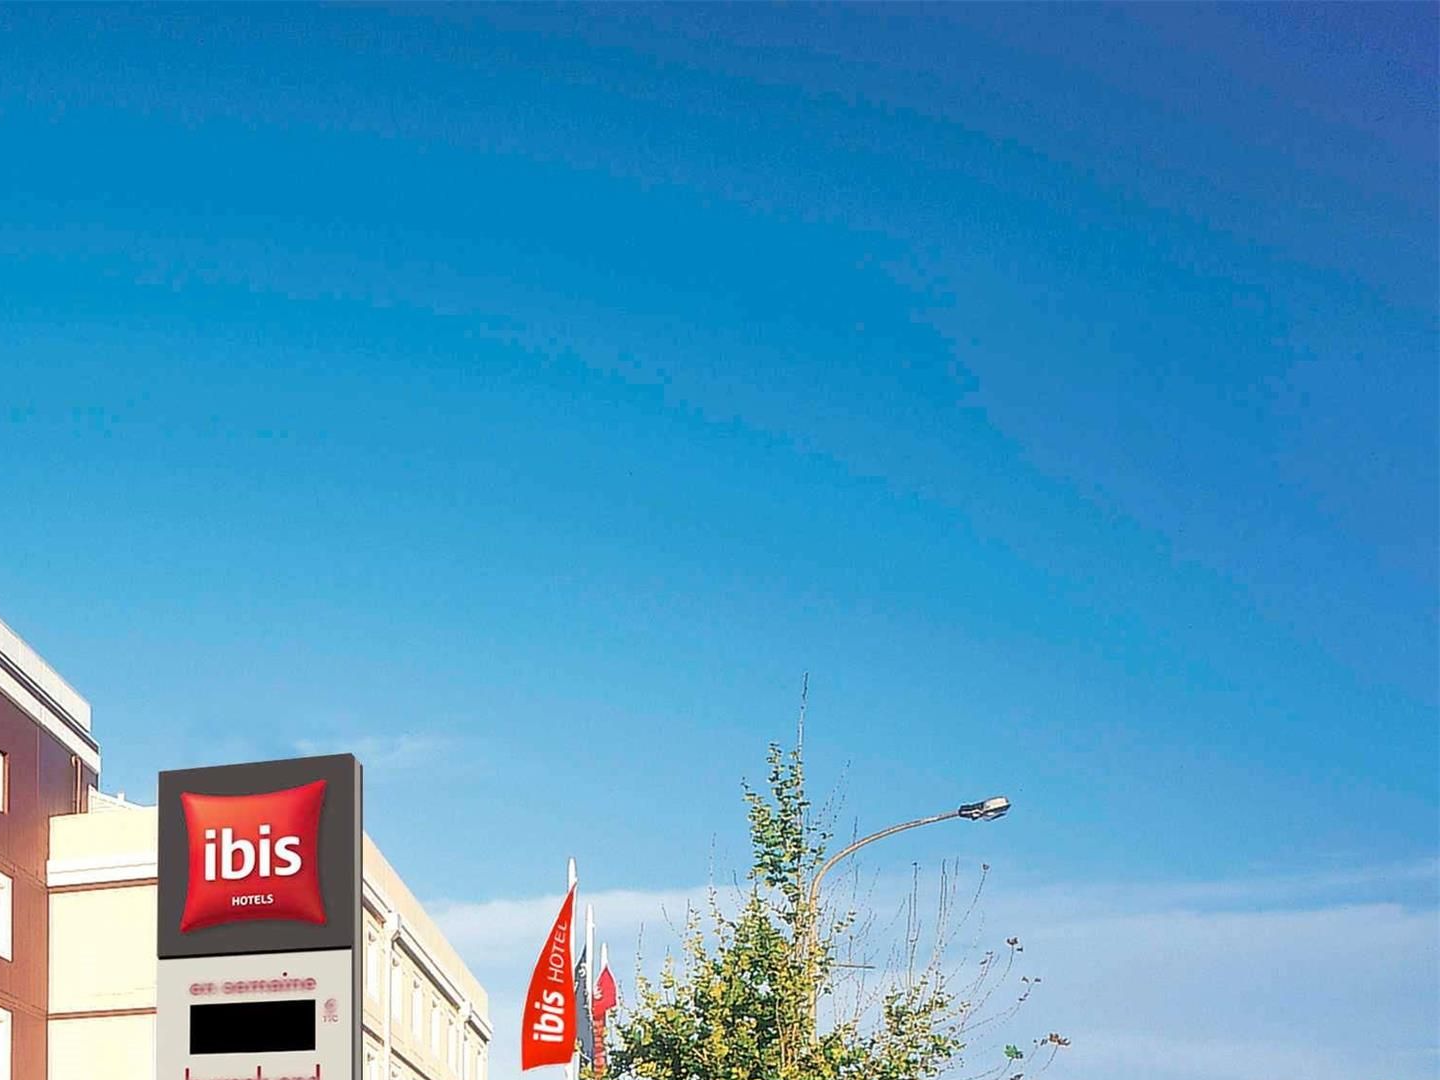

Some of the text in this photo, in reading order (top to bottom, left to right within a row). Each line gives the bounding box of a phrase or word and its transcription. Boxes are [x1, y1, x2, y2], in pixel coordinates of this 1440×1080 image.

[205, 824, 302, 881] ibis
[231, 893, 274, 906] HOTELS
[533, 921, 568, 1042] ibis HOTEL
